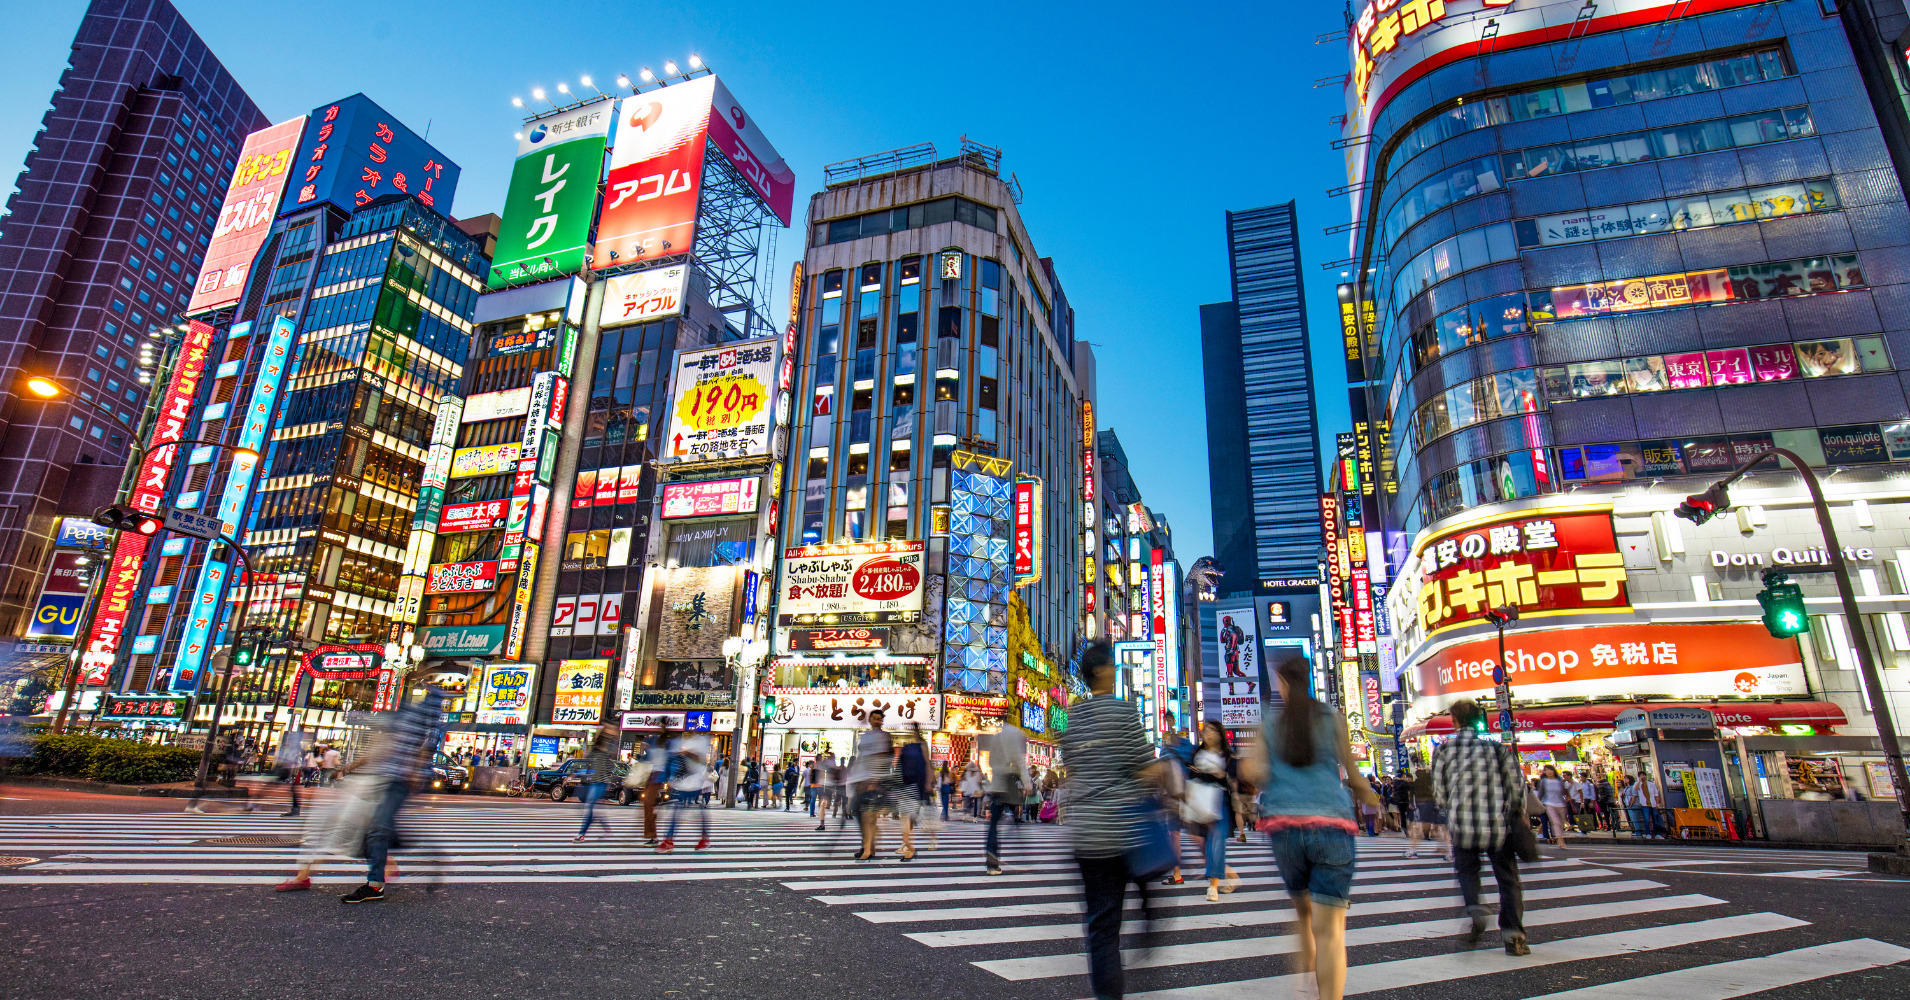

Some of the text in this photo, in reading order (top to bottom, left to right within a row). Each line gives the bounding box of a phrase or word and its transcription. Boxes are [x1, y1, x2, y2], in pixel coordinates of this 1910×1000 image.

[550, 111, 602, 136] 新生銀行
[297, 104, 340, 204] カラオケ館
[230, 148, 291, 191] パチンコ
[731, 139, 772, 198] アコム
[608, 168, 693, 210] アコム
[213, 187, 275, 239] エスパス
[525, 153, 571, 251] レイク
[1562, 214, 1606, 225] namco
[200, 262, 247, 295] 日拓
[622, 295, 677, 317] アイフル
[1341, 302, 1360, 360] 驚安の殿堂
[176, 331, 214, 396] パチンコ
[683, 345, 773, 371] 一軒め酒場
[1668, 361, 1703, 378] 東京
[690, 382, 759, 417] 190円
[150, 397, 188, 491] エスパス
[689, 437, 758, 455] 左の路地を右へ
[1823, 431, 1881, 447] don.quijote
[1354, 420, 1376, 496] ドン・キホーテ
[1643, 447, 1682, 464] 販売
[1825, 444, 1884, 457] ドン・キホーテ
[598, 473, 640, 490] アイフル
[667, 481, 740, 497] ブランド高価買取
[741, 500, 755, 510] 1F
[171, 510, 219, 531] 歌舞伎町
[874, 544, 888, 553] for
[889, 543, 896, 552] 2
[1423, 520, 1559, 575] 驚安の殿堂
[1710, 550, 1764, 567] Don
[432, 562, 484, 578] しゃぶしゃぶ
[518, 559, 532, 591] 金の蔵
[788, 558, 854, 574] しゃぶしゃぶ
[107, 555, 142, 613] パチンコ
[430, 577, 474, 591] うどんすき
[788, 583, 849, 600] 食べ放題!
[859, 573, 903, 595] 2,480
[1152, 564, 1165, 619] SHIDAX
[1263, 578, 1319, 588] HOTEL GRACERY
[37, 604, 80, 625] GU
[554, 600, 620, 625] アコム
[903, 611, 920, 622] 5F
[179, 567, 223, 682] カラオケ館
[1156, 639, 1164, 654] BIC
[1243, 634, 1255, 671] 呼んだ?
[1589, 641, 1679, 667] 免税店
[1156, 656, 1165, 682] DRUG
[1437, 648, 1580, 687] Tax Free Shop
[492, 671, 528, 688] まんが
[570, 672, 605, 690] 金の蔵
[112, 700, 177, 716] カラオケ館
[946, 696, 1009, 708] OKONOMI YAKI
[1221, 696, 1260, 706] DEADPOOL
[1365, 676, 1382, 727] カラオケ
[560, 707, 600, 721] チカラめし
[1383, 748, 1397, 779] カラオ
